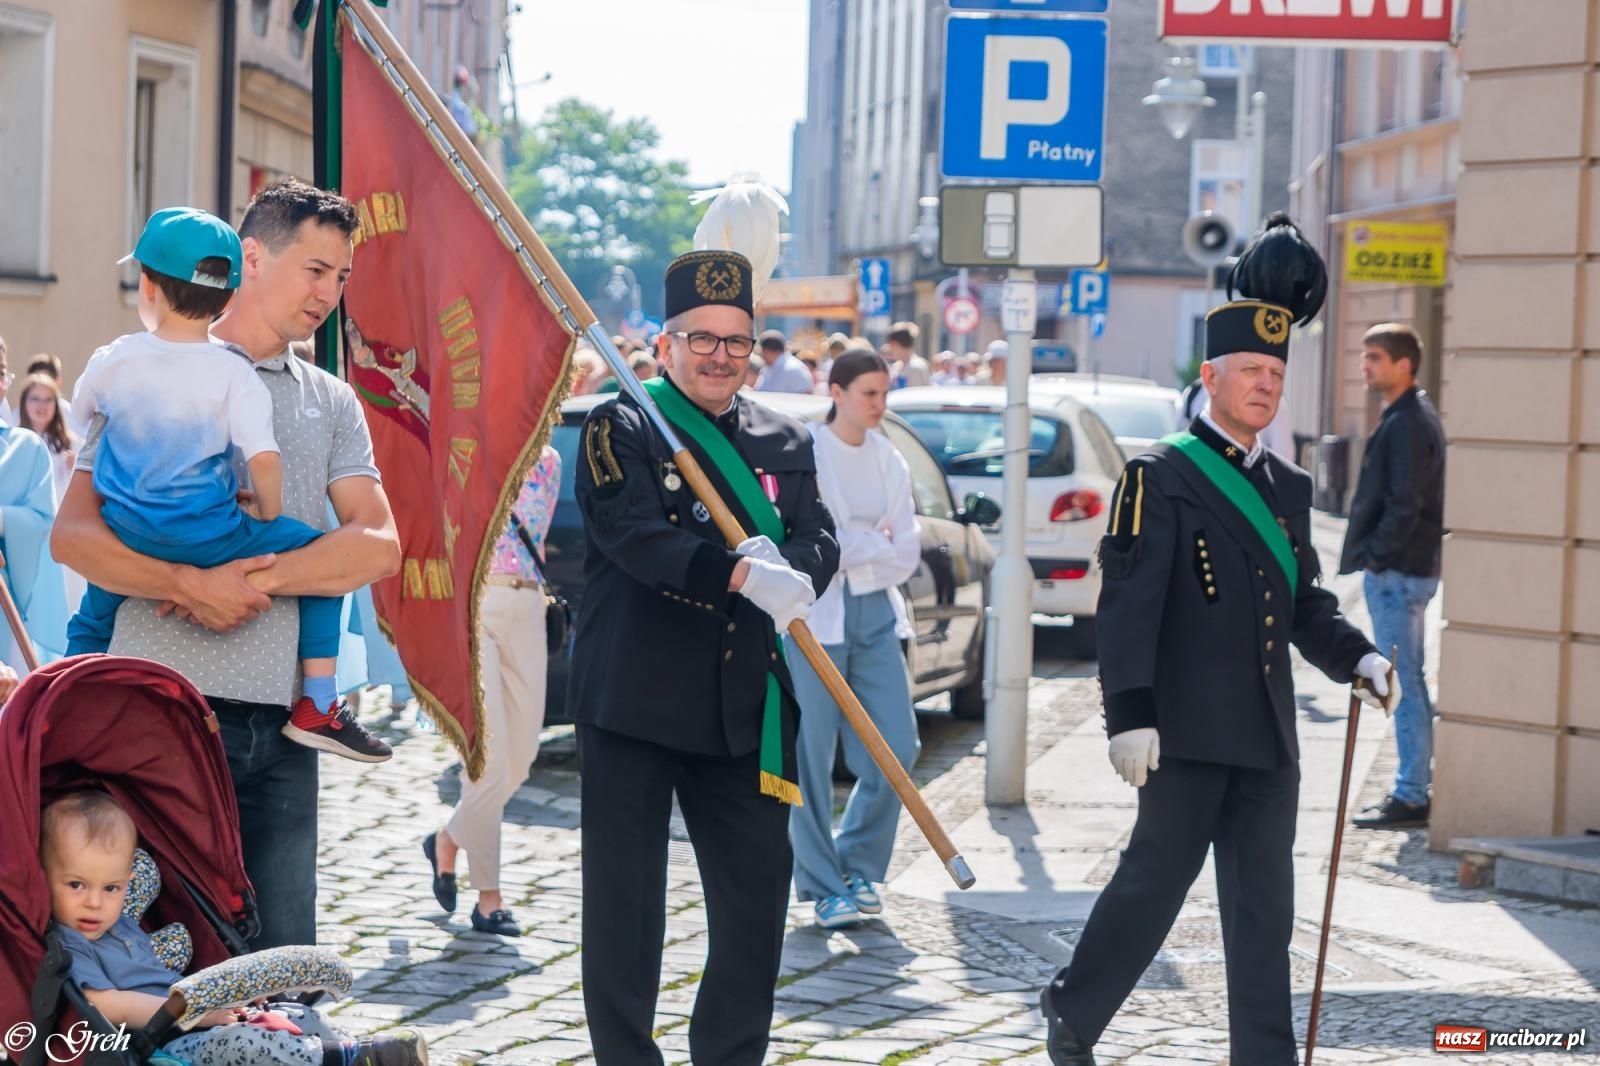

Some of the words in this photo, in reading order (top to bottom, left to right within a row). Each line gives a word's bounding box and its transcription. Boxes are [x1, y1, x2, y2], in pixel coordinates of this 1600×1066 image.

[980, 34, 1072, 160] P
[1027, 139, 1096, 168] Płatny
[1079, 274, 1103, 311] P
